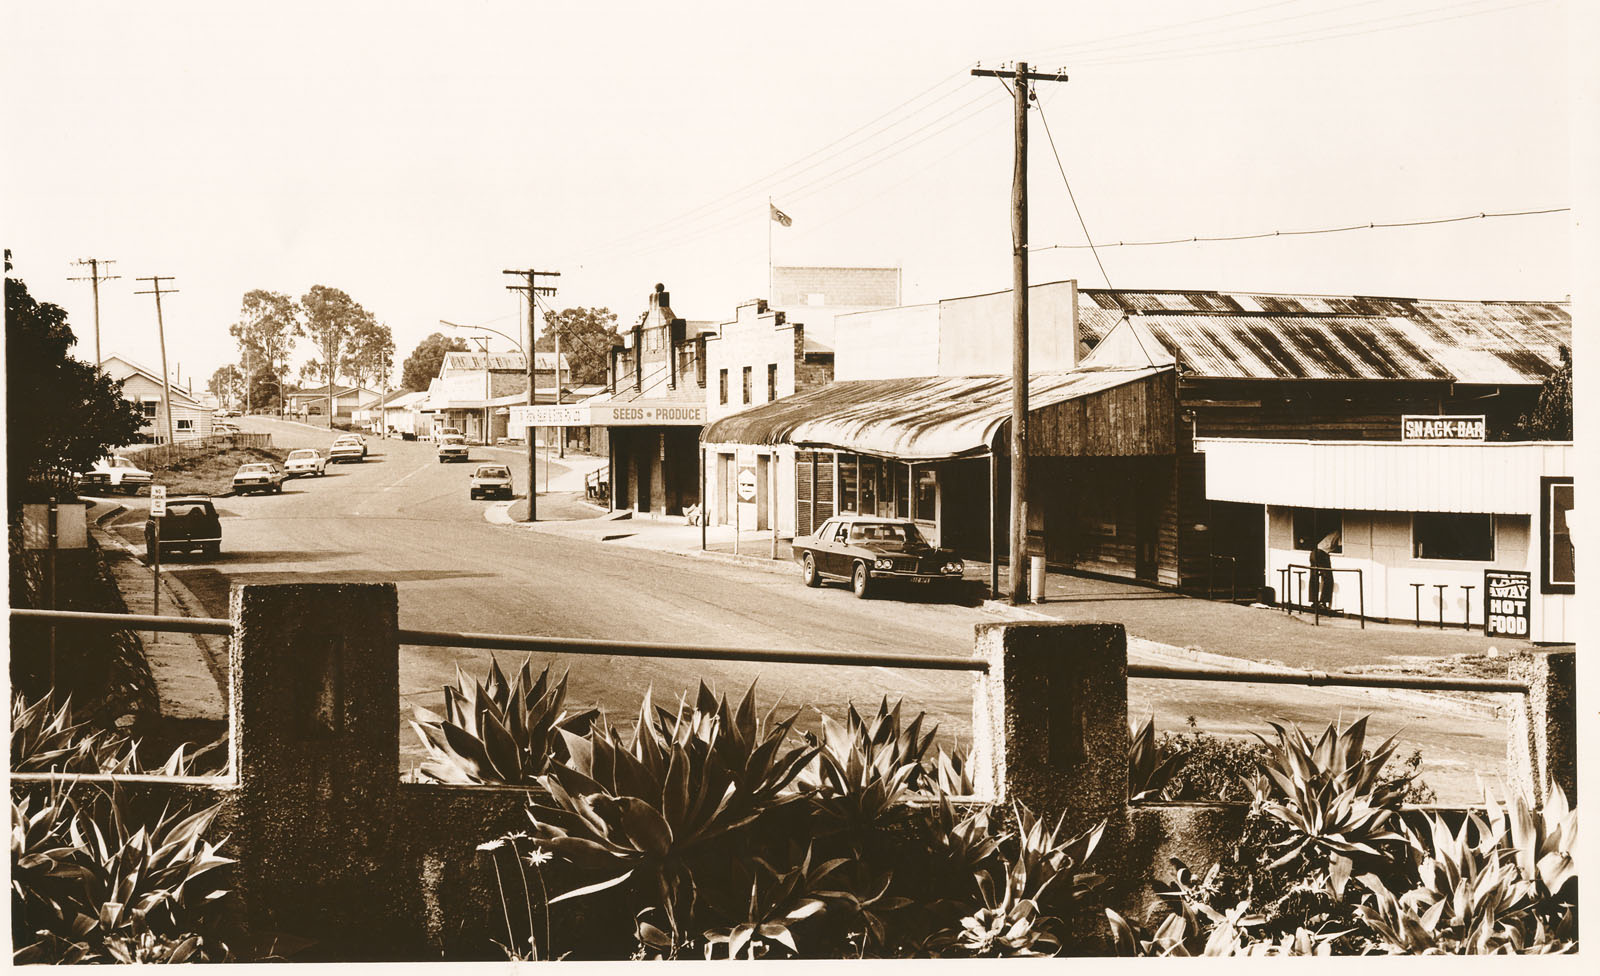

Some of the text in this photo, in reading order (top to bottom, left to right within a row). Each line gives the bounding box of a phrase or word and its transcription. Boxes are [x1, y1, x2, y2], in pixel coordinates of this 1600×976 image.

[612, 408, 701, 420] SEEDS PRODUCE
[1406, 421, 1483, 438] SNACK-BAR
[1489, 584, 1530, 599] AWAY
[1490, 599, 1527, 615] HOT
[1488, 615, 1527, 635] FOOD
